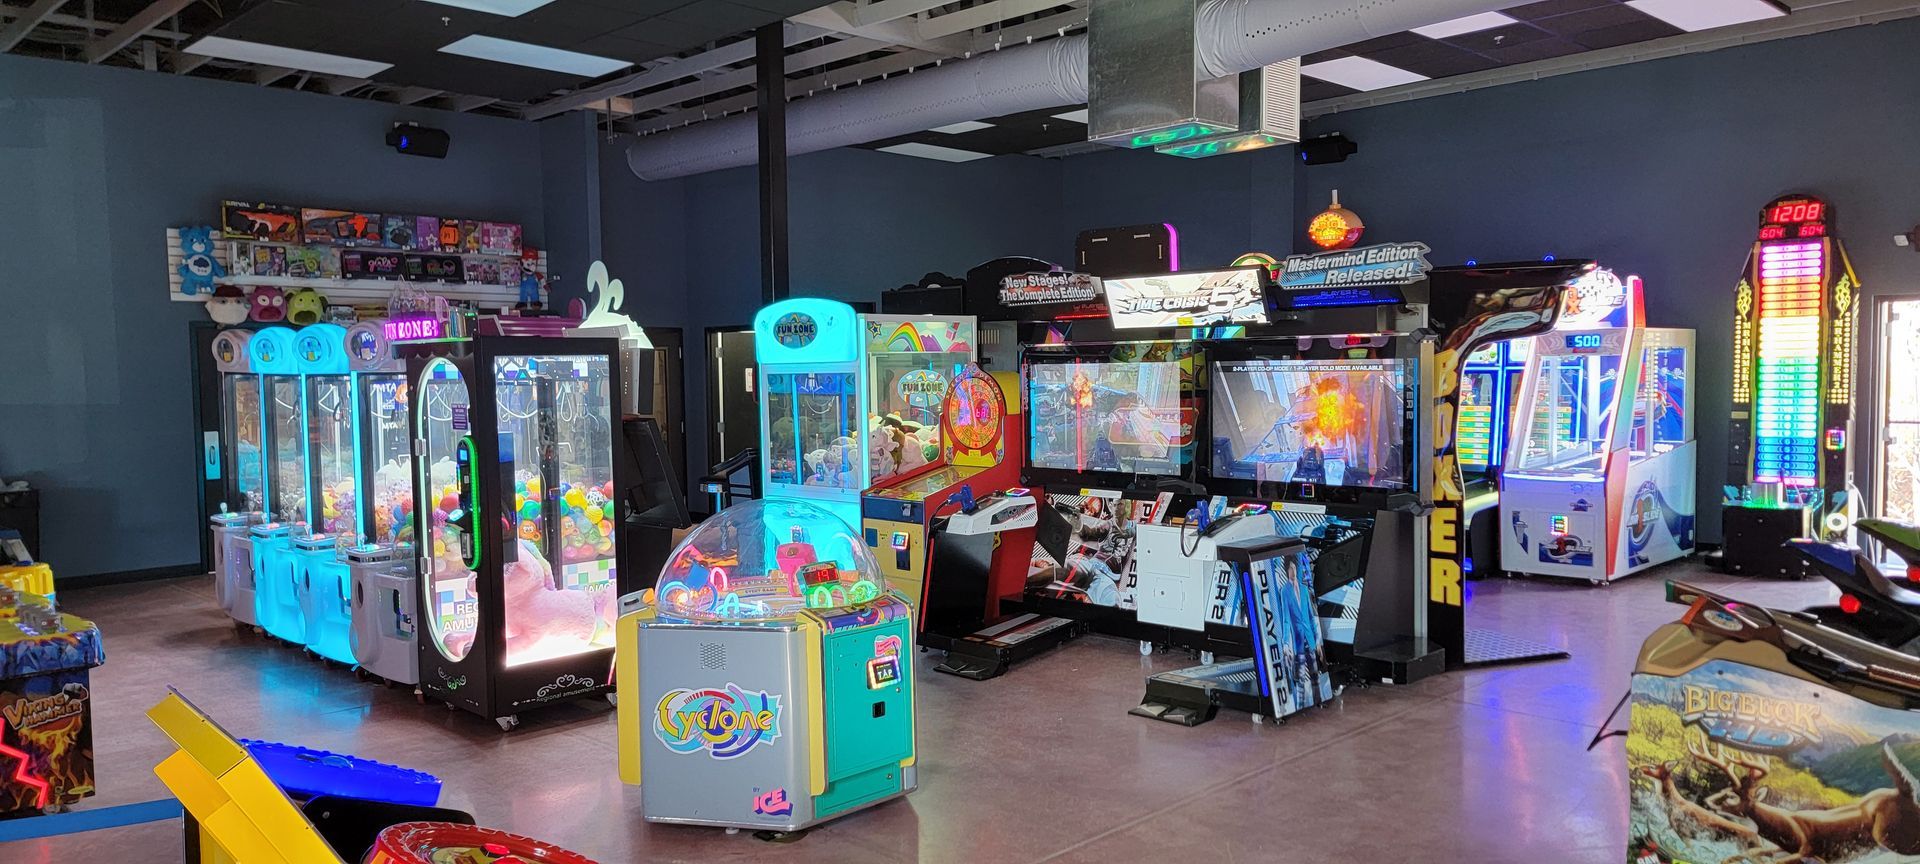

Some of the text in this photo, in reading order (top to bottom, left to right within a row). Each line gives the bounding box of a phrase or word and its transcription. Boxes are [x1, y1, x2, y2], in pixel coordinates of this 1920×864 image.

[1773, 203, 1820, 222] 1208
[1761, 228, 1784, 238] 604
[1801, 226, 1824, 236] 604
[1287, 246, 1419, 273] Mastermind Edition
[1005, 273, 1069, 289] New Stages!
[1325, 262, 1415, 284] Released!
[1000, 286, 1096, 302] The Complete Edition!
[1128, 286, 1239, 314] TIME CRISIS 5
[777, 323, 815, 335] FUN ZONE
[902, 381, 944, 393] FUN ZONE
[1406, 357, 1414, 409] PLAYER
[1431, 349, 1462, 607] BOXER
[1211, 604, 1225, 620] 2
[1257, 569, 1287, 706] PLAYER 2
[877, 668, 893, 679] TAP
[536, 686, 596, 702] Regional amusement
[3, 693, 66, 729] VIKING
[25, 702, 81, 726] HAMMER
[658, 690, 774, 740] Cyclone
[1684, 684, 1821, 736] BIG BUCK
[752, 786, 793, 817] ICE
